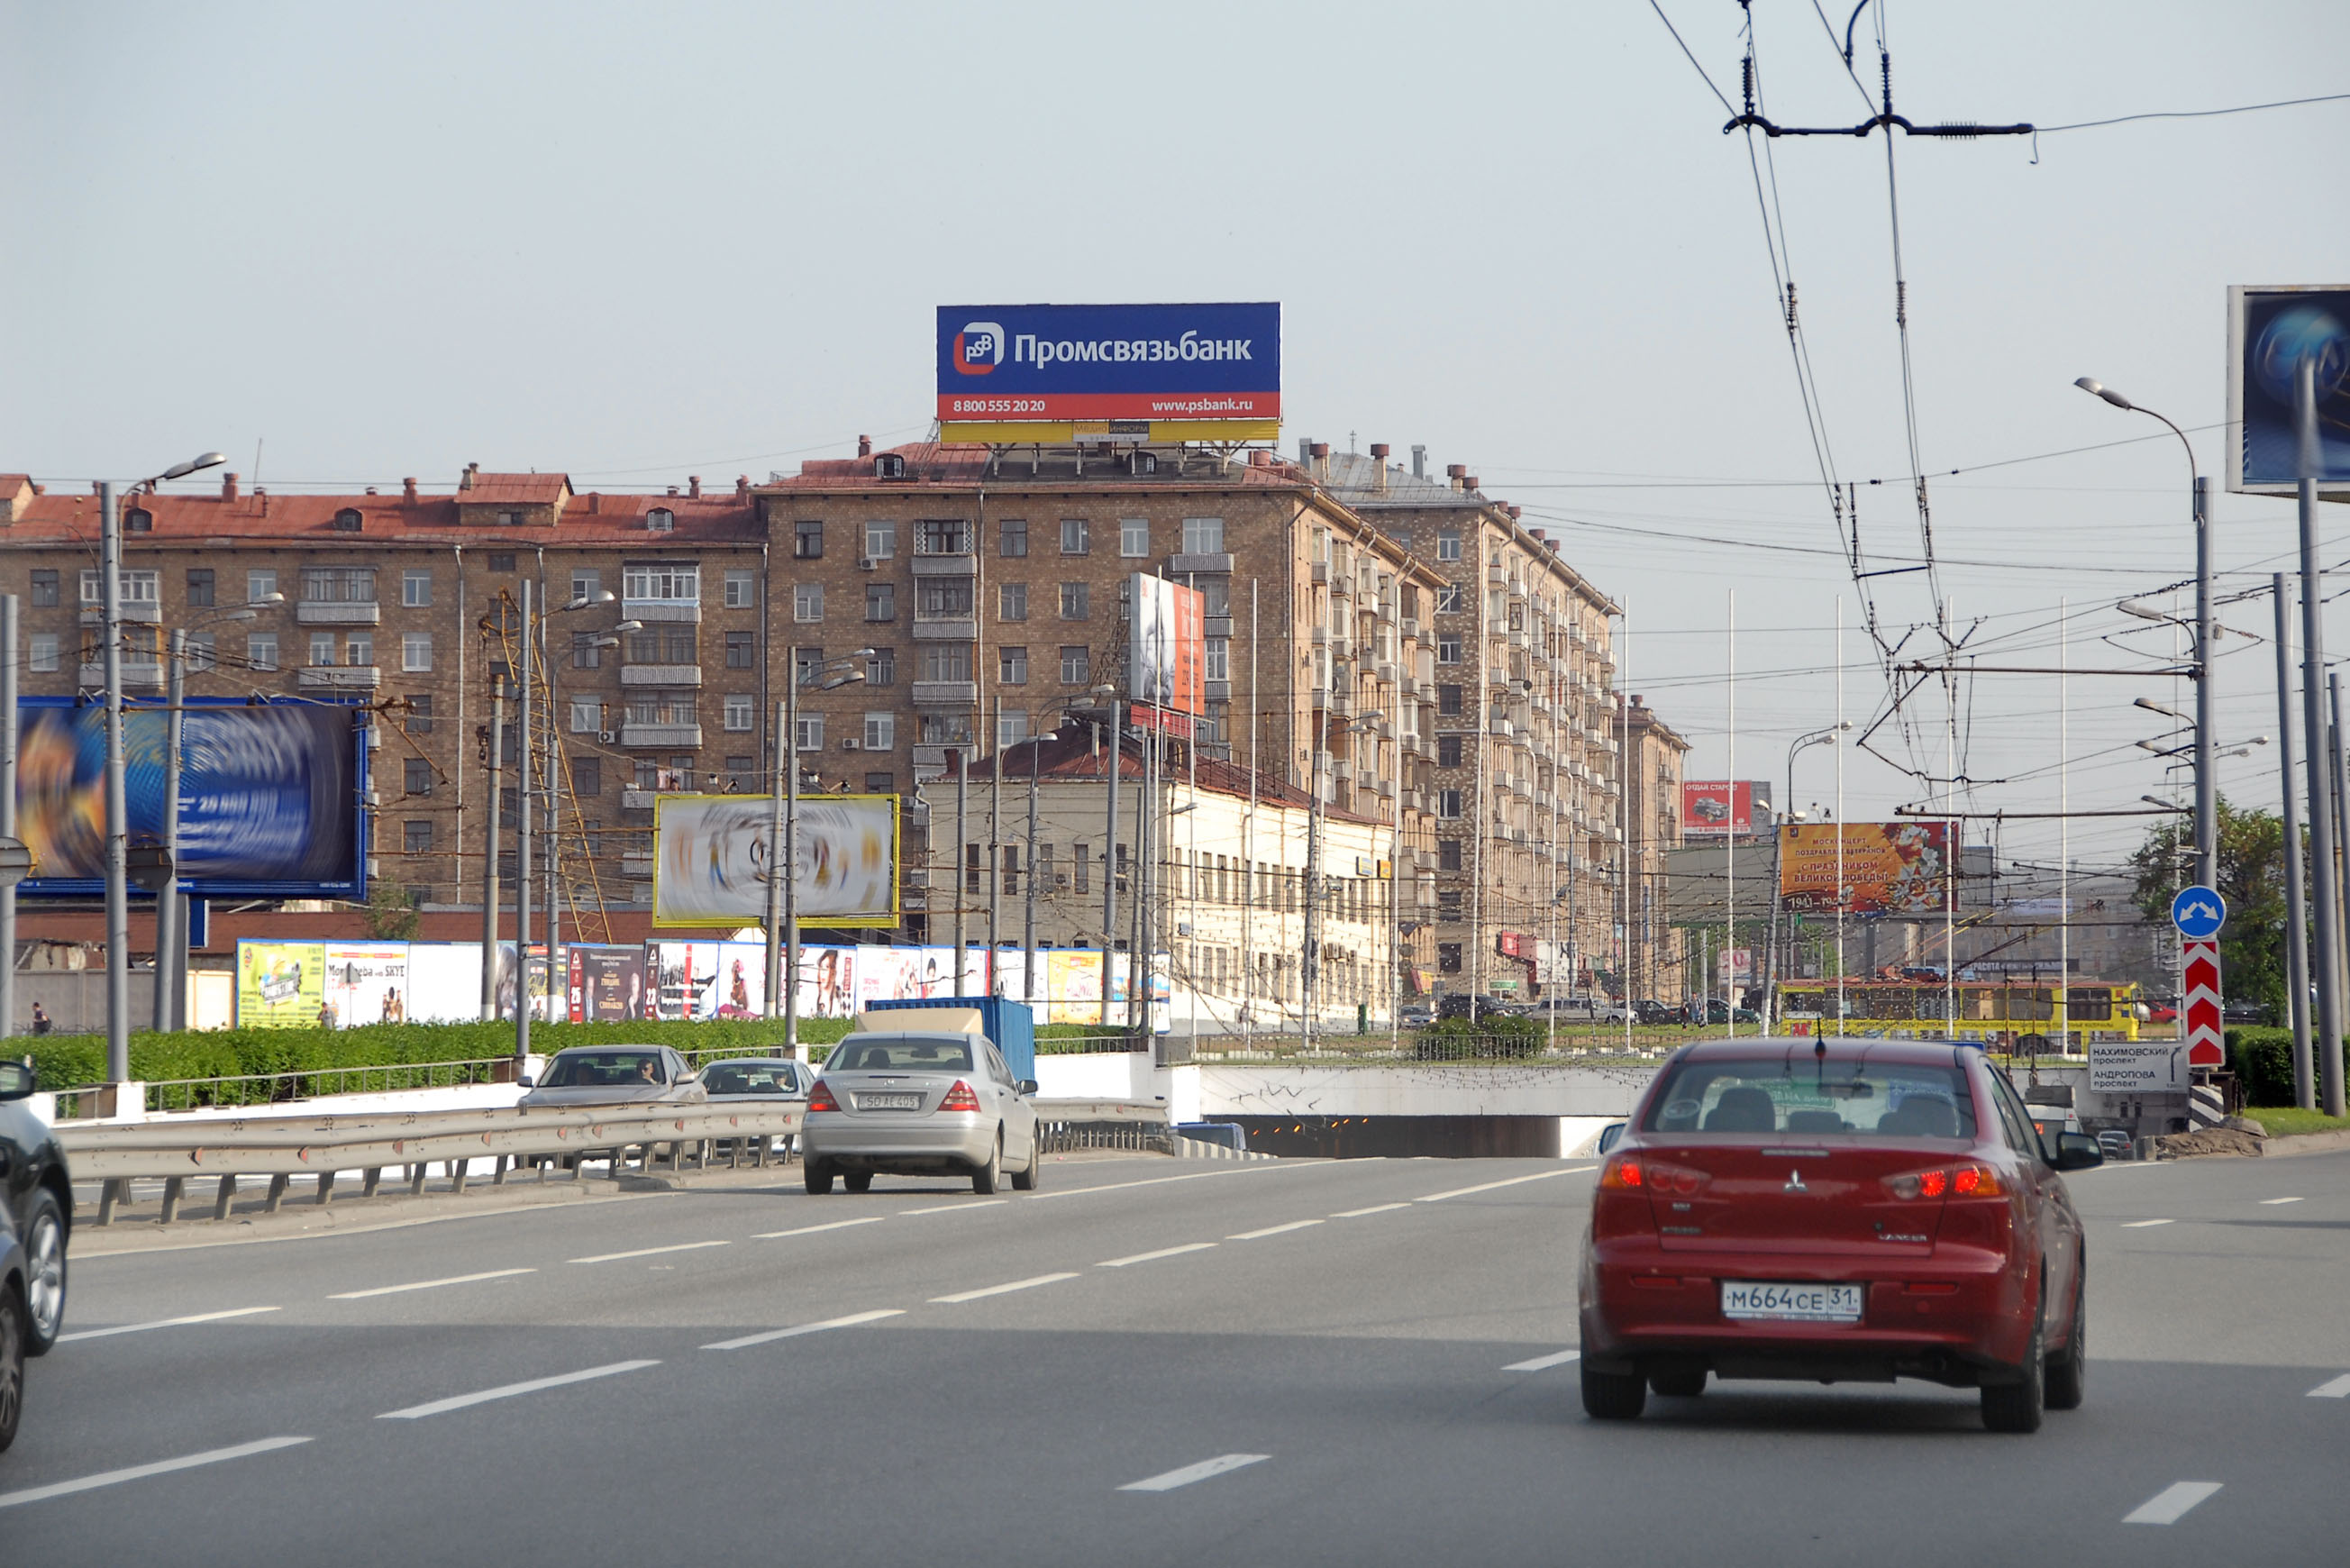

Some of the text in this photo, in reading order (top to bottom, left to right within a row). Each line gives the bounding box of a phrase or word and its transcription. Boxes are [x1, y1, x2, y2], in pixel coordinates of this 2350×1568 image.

[1016, 330, 1252, 369] Промсвязьбанк
[953, 400, 1045, 412] 8 800 555 20 20
[1152, 397, 1252, 414] www.psbank.ru
[385, 965, 405, 977] SKYE
[2093, 1047, 2169, 1056] НАХИМОВСКИЙ
[2093, 1057, 2136, 1065] проспект
[2094, 1071, 2156, 1079] АНДРОПОВА
[1830, 1288, 1853, 1305] 31
